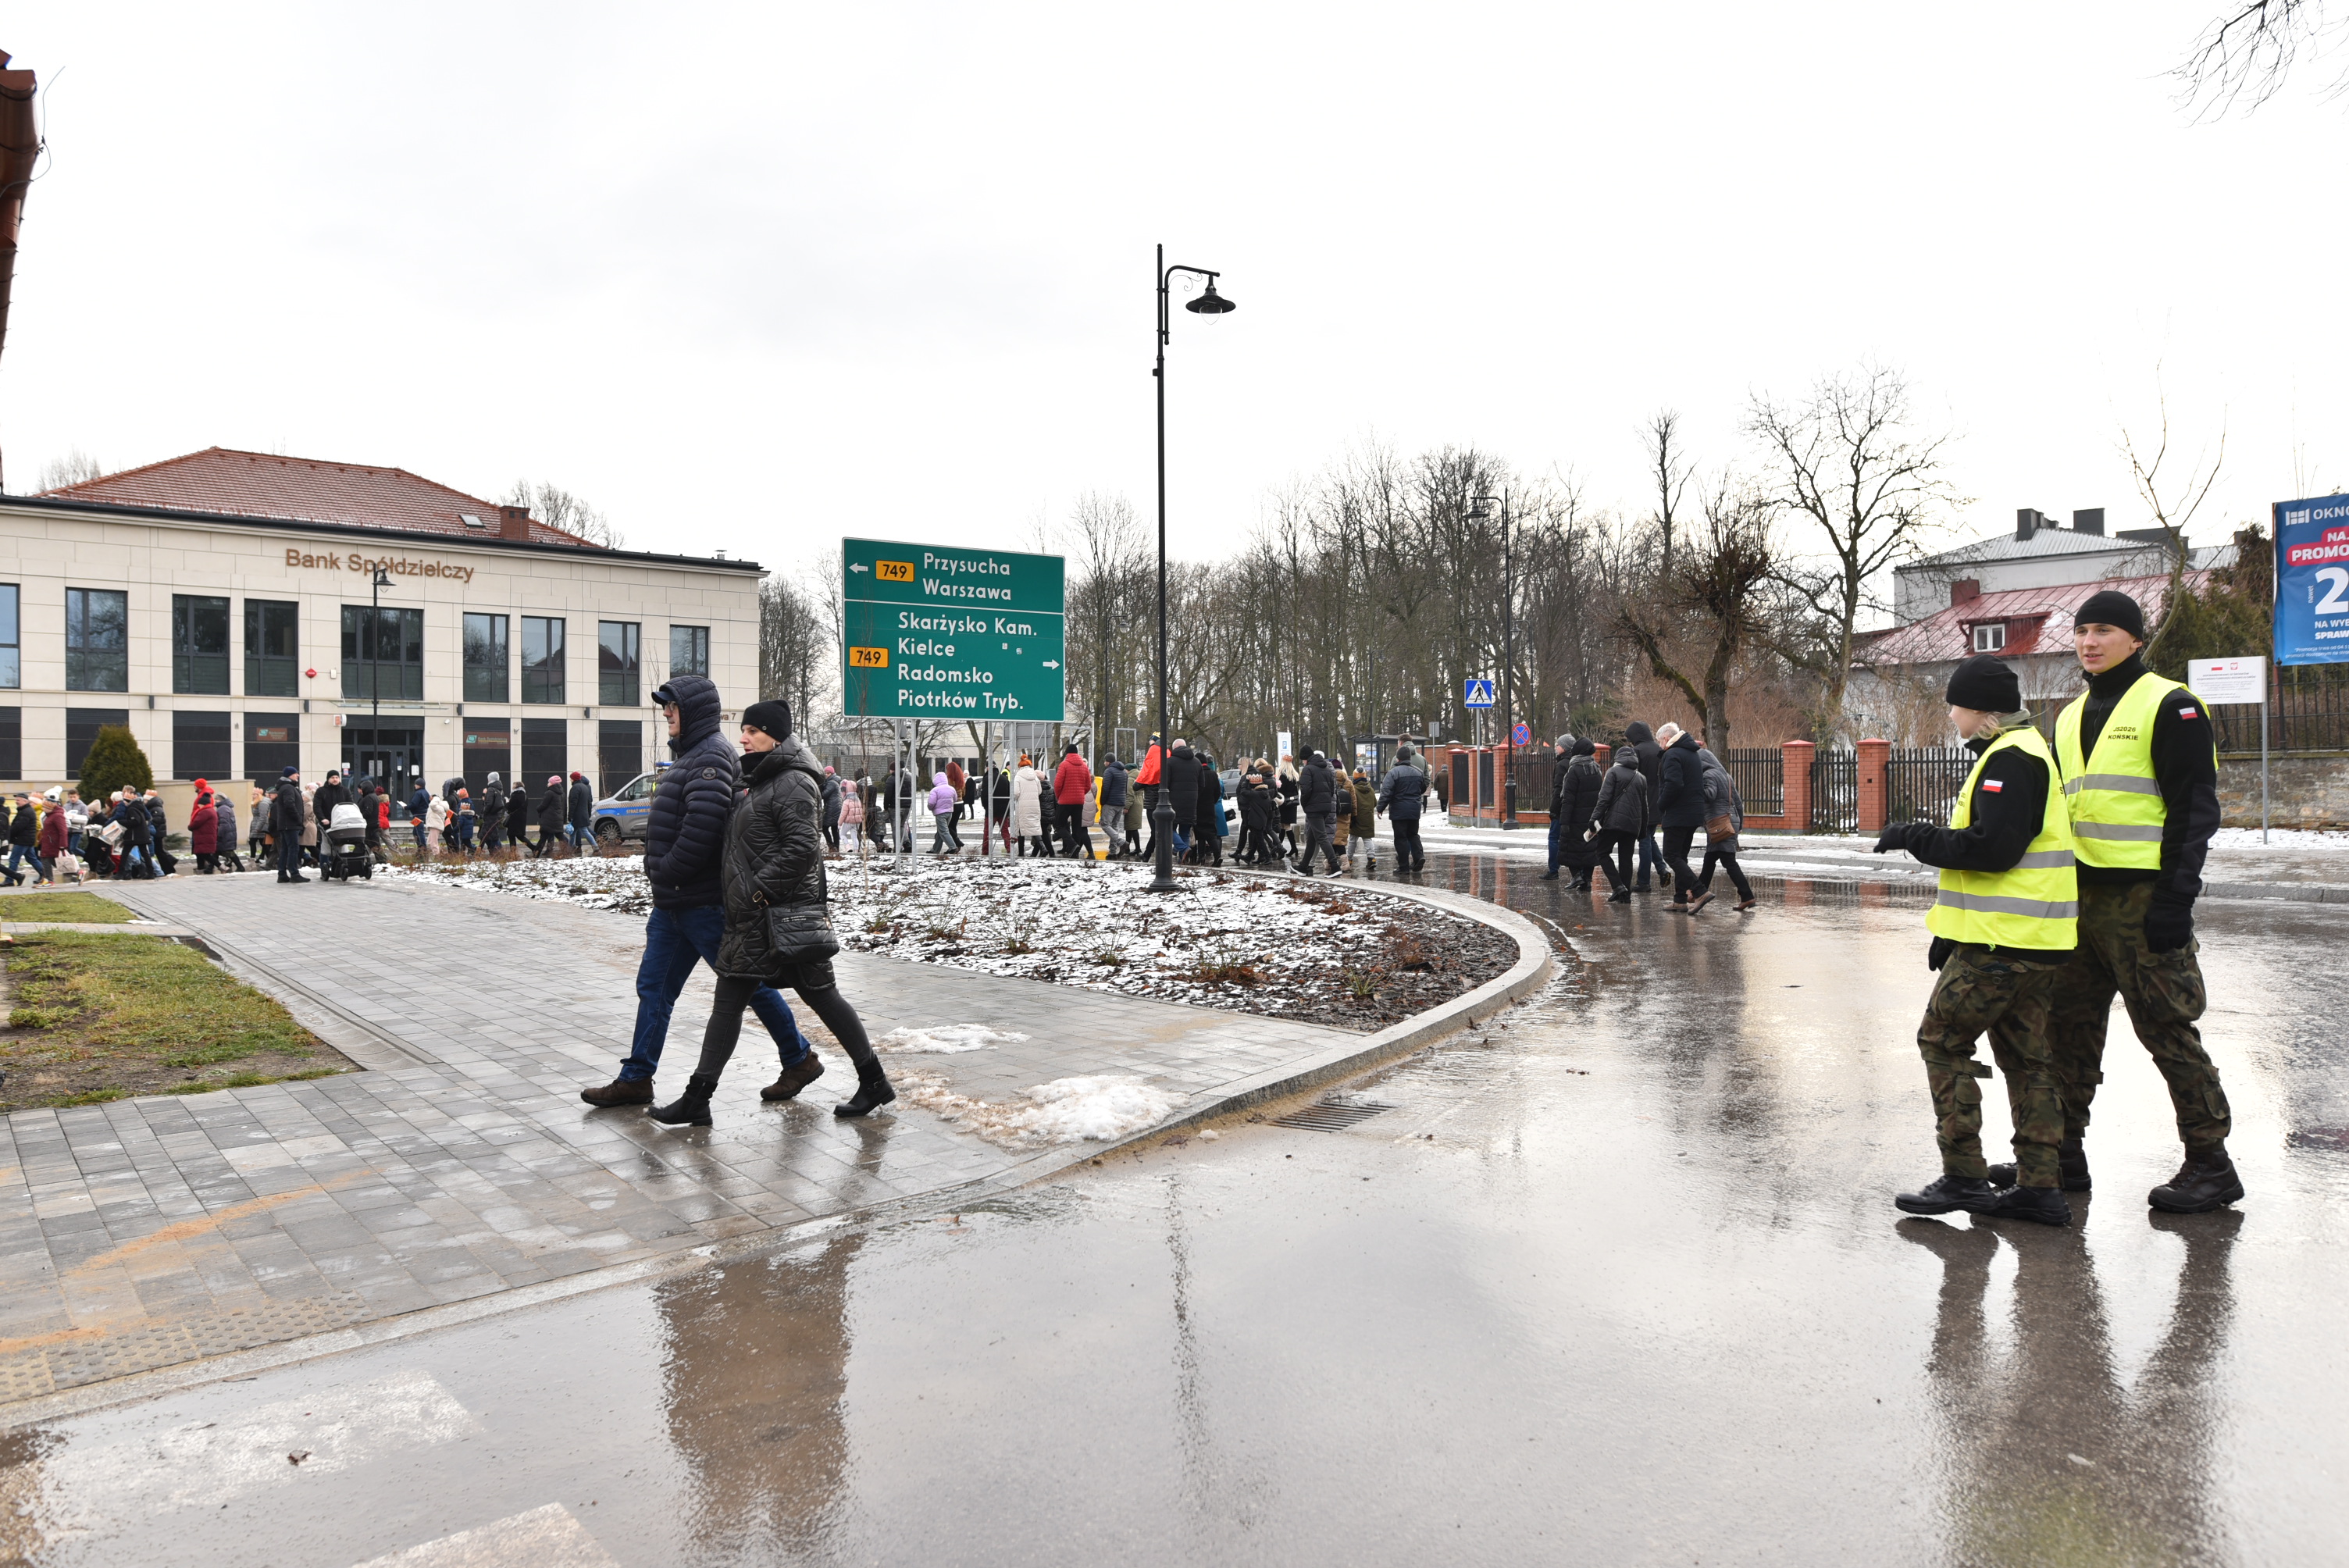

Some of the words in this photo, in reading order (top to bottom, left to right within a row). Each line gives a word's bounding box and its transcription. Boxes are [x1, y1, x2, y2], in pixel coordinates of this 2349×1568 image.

[2327, 531, 2349, 543] NA
[2292, 544, 2349, 561] PROMO
[286, 548, 340, 570] Bank
[348, 553, 474, 583] Spółdzielczy
[882, 564, 907, 579] 749
[924, 552, 1011, 576] Przysucha
[922, 578, 1011, 600] Warszawa
[898, 611, 987, 636] Skarżysko
[995, 617, 1037, 636] Kam.
[2315, 620, 2329, 629] NA
[898, 637, 955, 657] Kielce
[856, 650, 881, 665] 749
[898, 663, 993, 684] Radomsko
[898, 689, 977, 708] Piotrków
[982, 692, 1024, 714] Tryb.
[731, 712, 736, 721] 7
